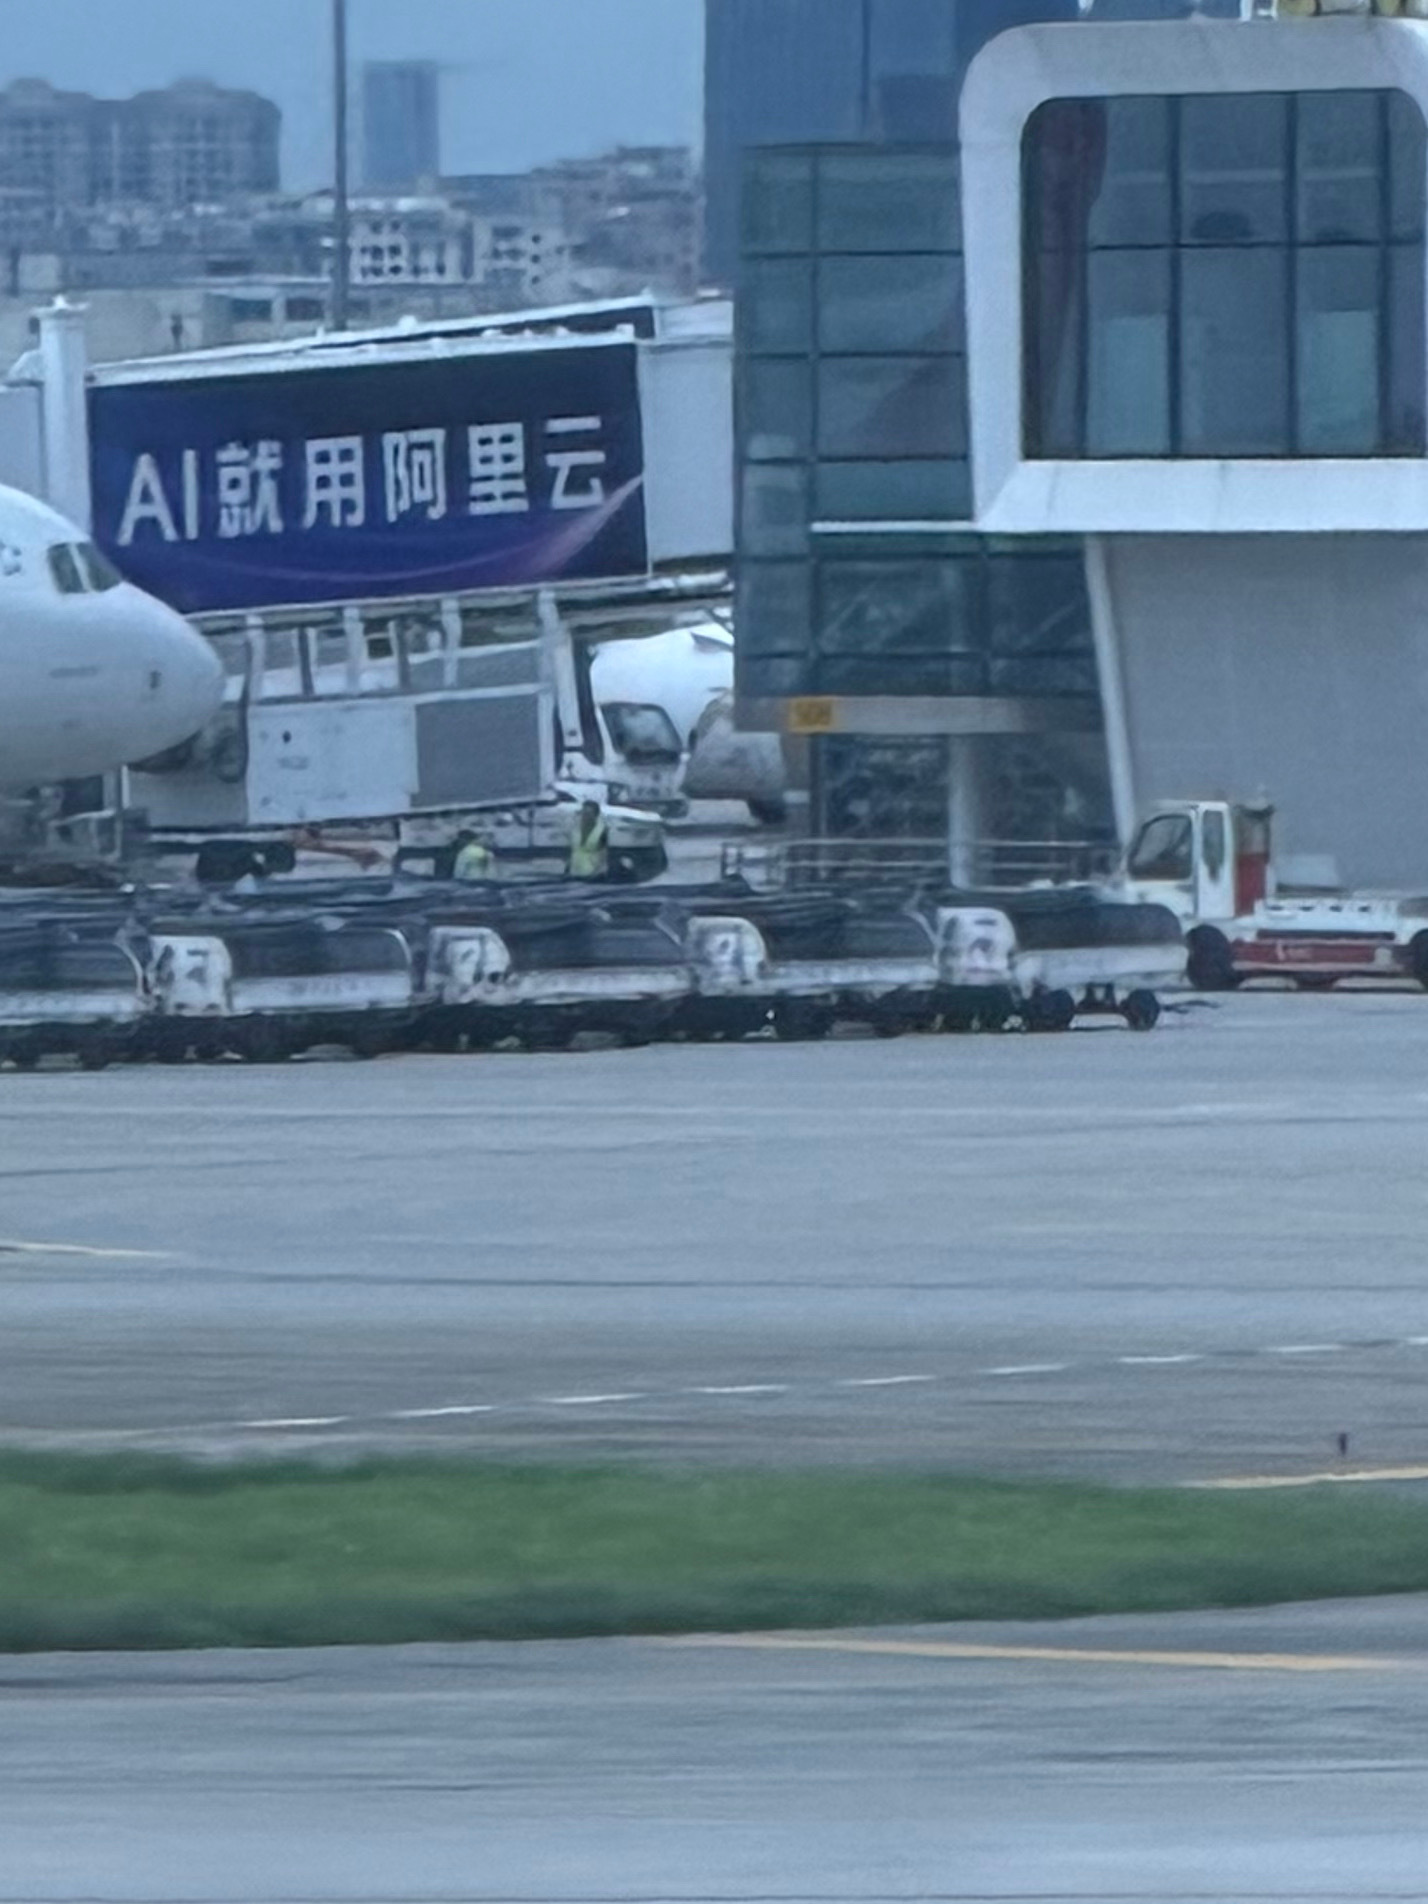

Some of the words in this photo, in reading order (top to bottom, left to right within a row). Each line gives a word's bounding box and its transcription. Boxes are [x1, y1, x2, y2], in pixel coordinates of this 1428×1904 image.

[119, 416, 606, 545] AI就用阿里云
